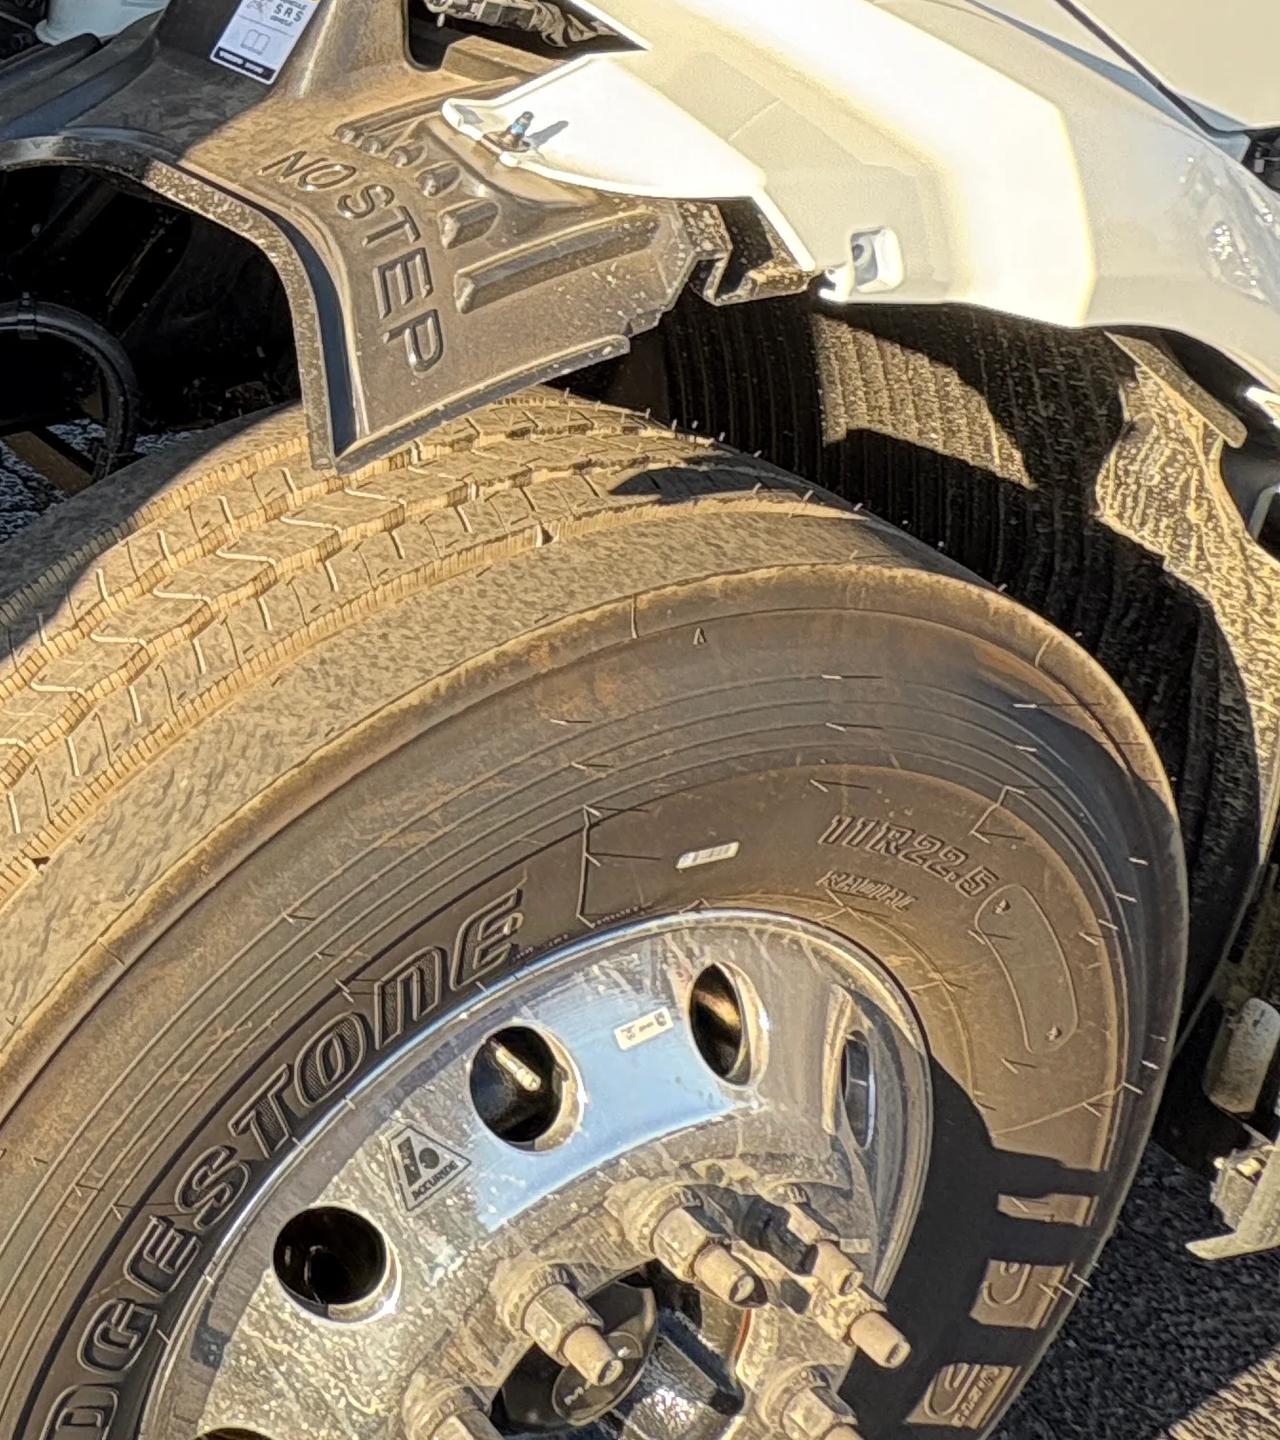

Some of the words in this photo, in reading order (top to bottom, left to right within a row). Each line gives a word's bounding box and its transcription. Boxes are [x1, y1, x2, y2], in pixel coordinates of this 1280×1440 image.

[258, 149, 358, 193] NO
[337, 184, 446, 377] STEP
[817, 814, 1000, 899] 11R22.5
